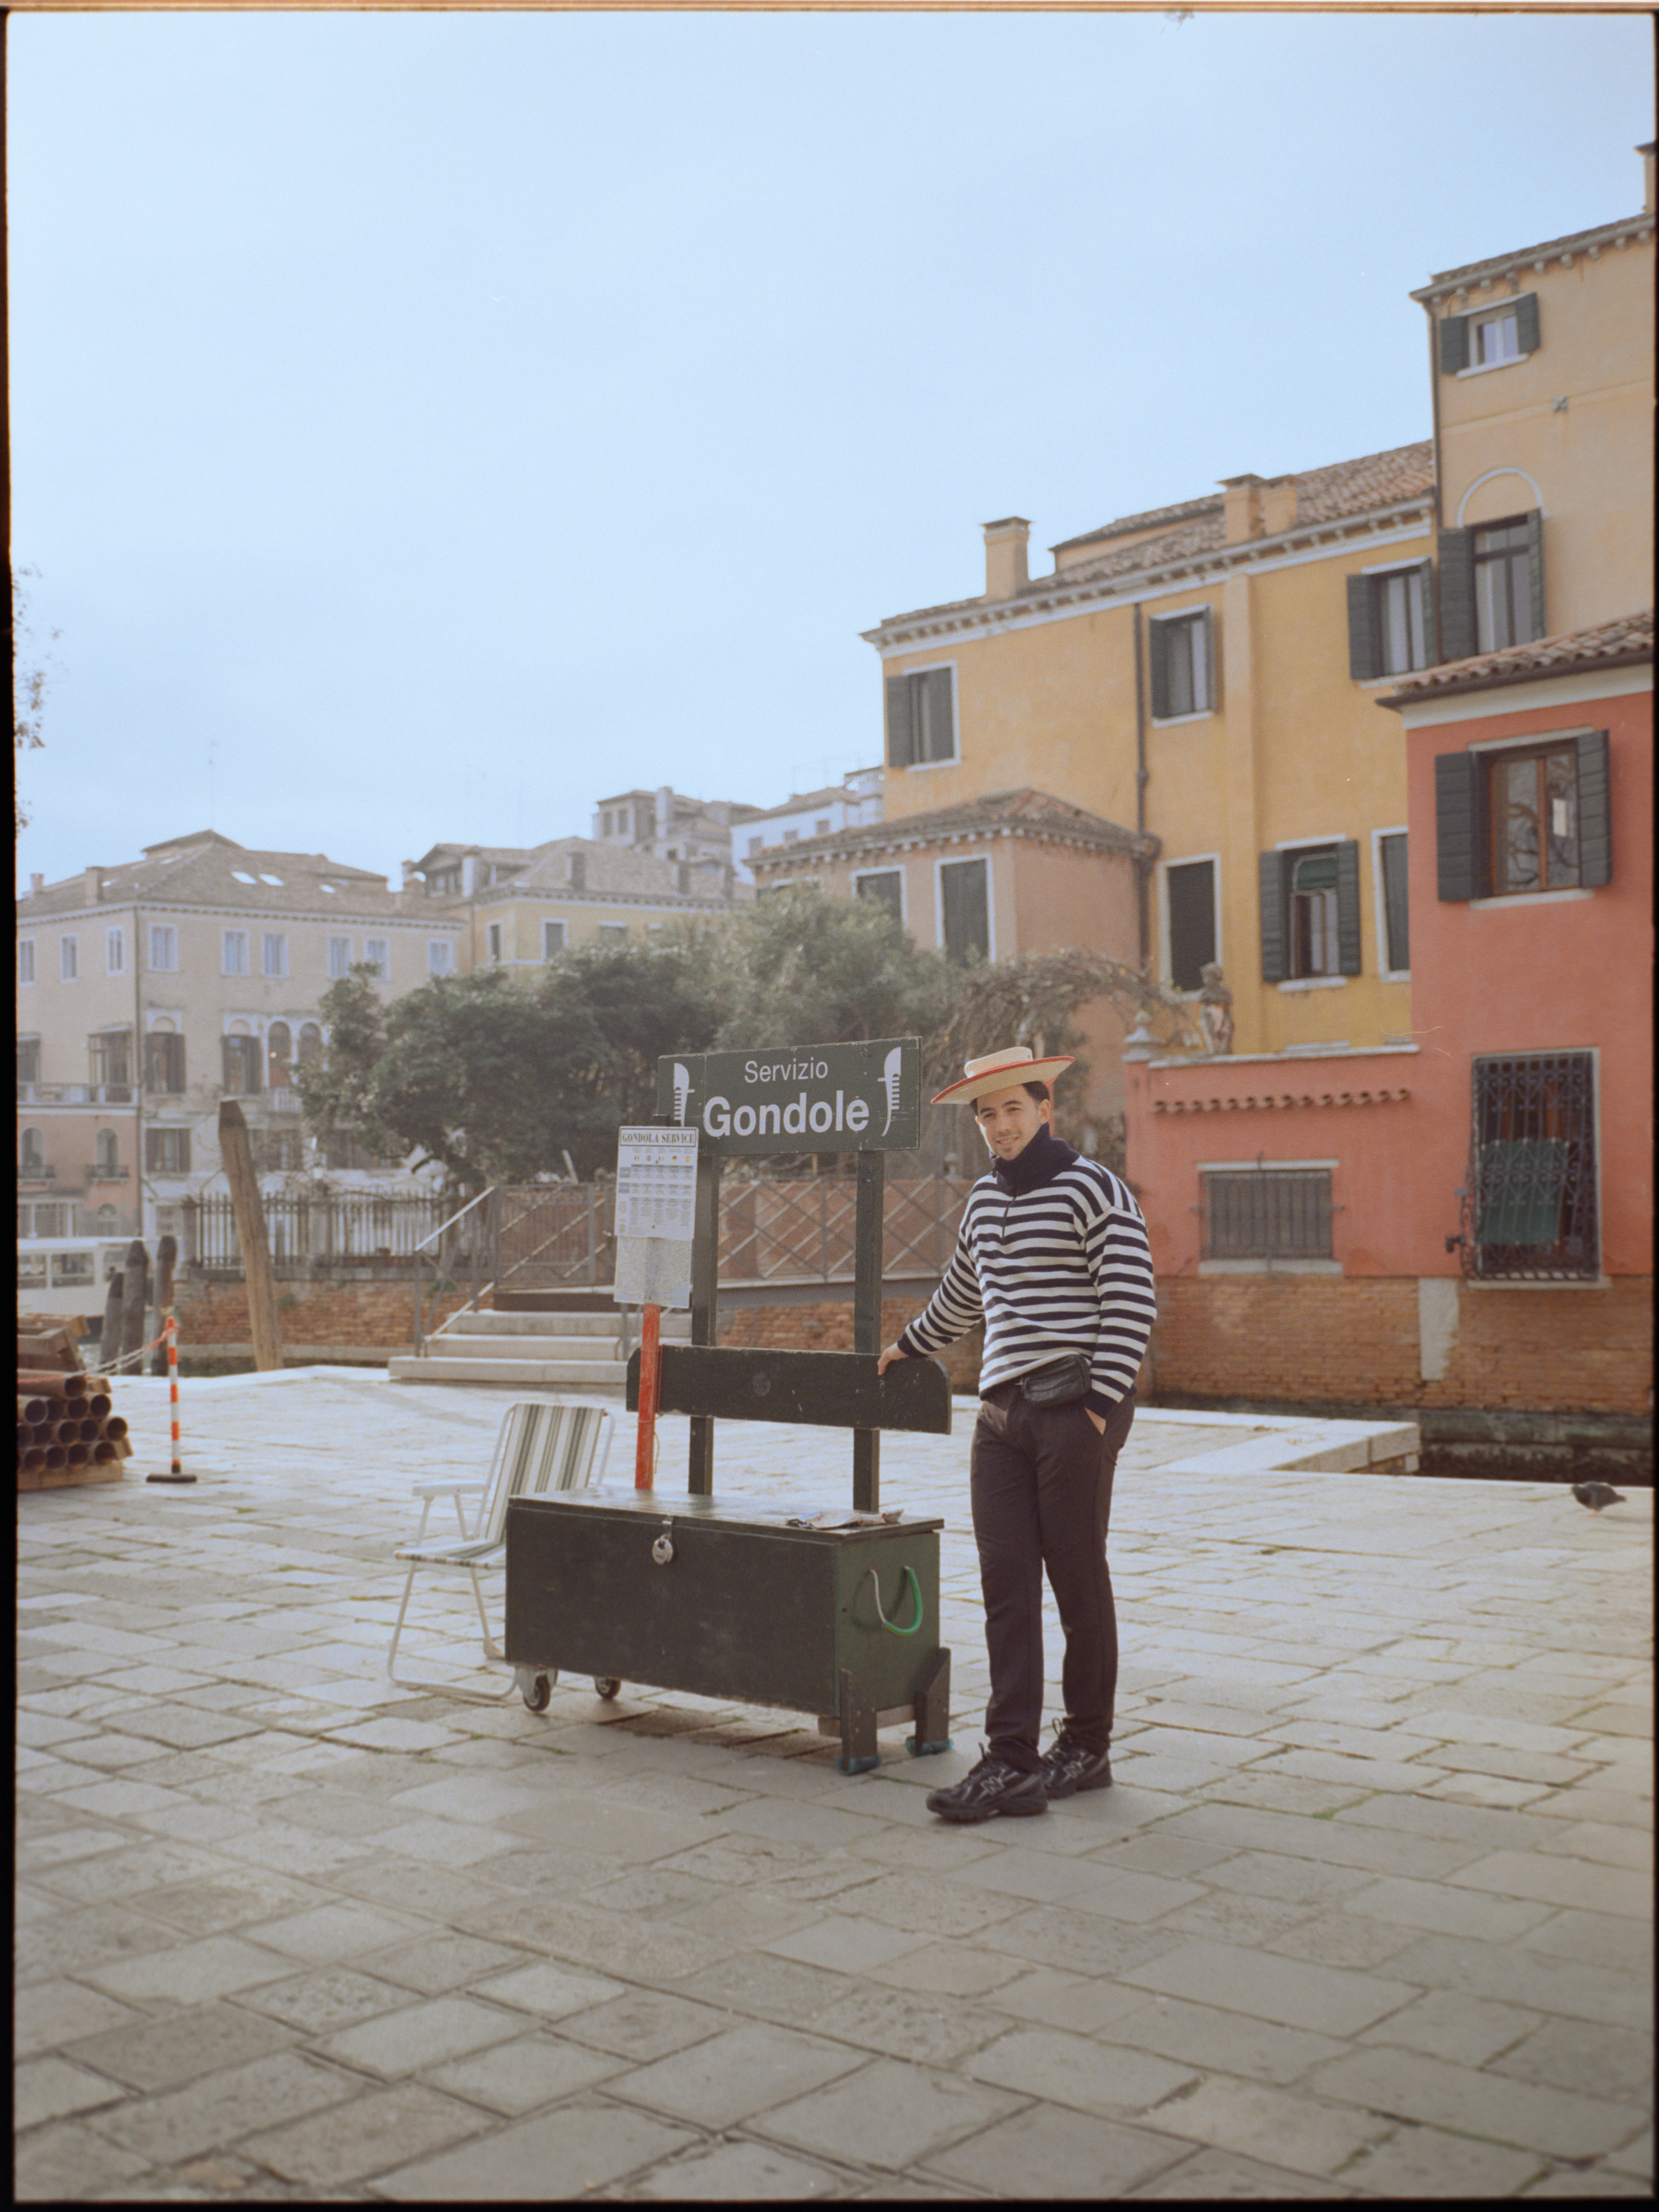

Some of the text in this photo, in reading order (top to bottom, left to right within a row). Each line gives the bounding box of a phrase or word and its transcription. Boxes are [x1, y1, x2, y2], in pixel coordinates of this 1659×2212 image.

[745, 1057, 828, 1083] Servizio
[703, 1090, 869, 1137] Gondole
[622, 1133, 695, 1144] GONDOLA SERVICE
